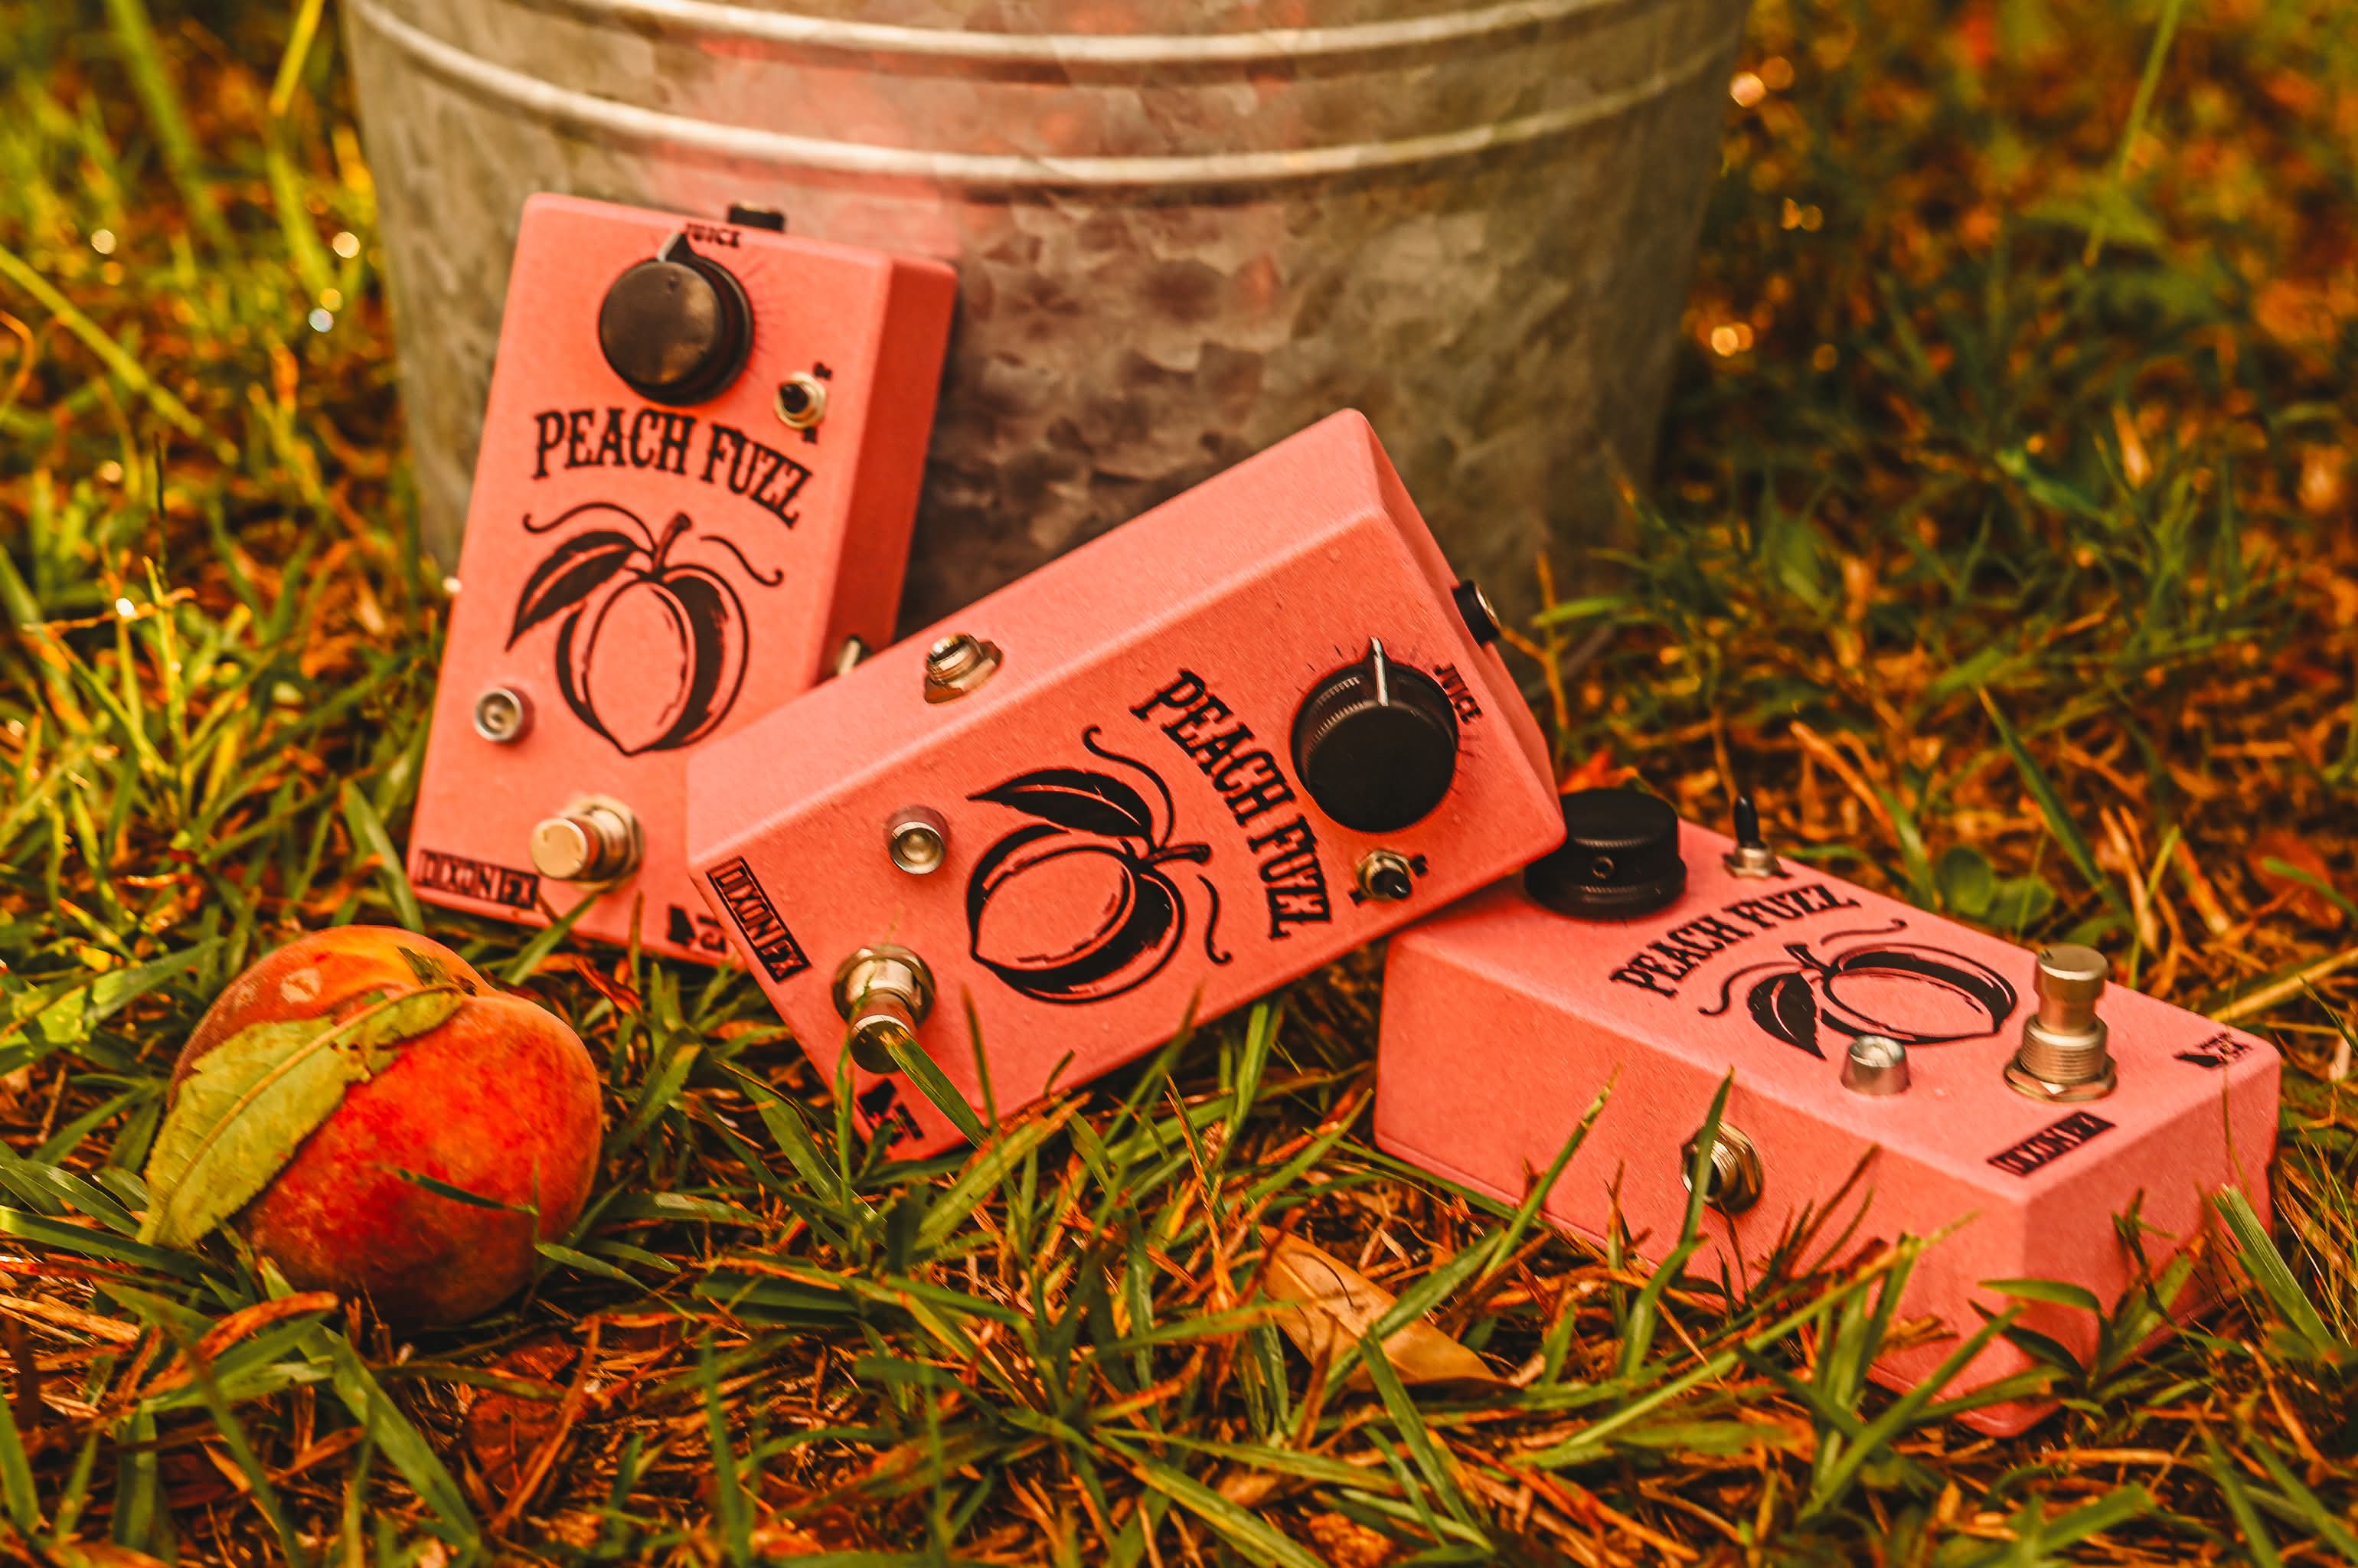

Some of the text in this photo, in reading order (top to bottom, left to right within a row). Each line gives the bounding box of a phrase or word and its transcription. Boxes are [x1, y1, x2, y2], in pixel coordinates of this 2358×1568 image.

[531, 407, 813, 528] PEACH FUZZ
[1434, 662, 1483, 724] JUICE
[1128, 668, 1331, 941] PEACH FUZZ
[709, 859, 786, 949] DIXON
[760, 939, 803, 978] FX
[1609, 884, 1861, 998] PEACH FUZZ
